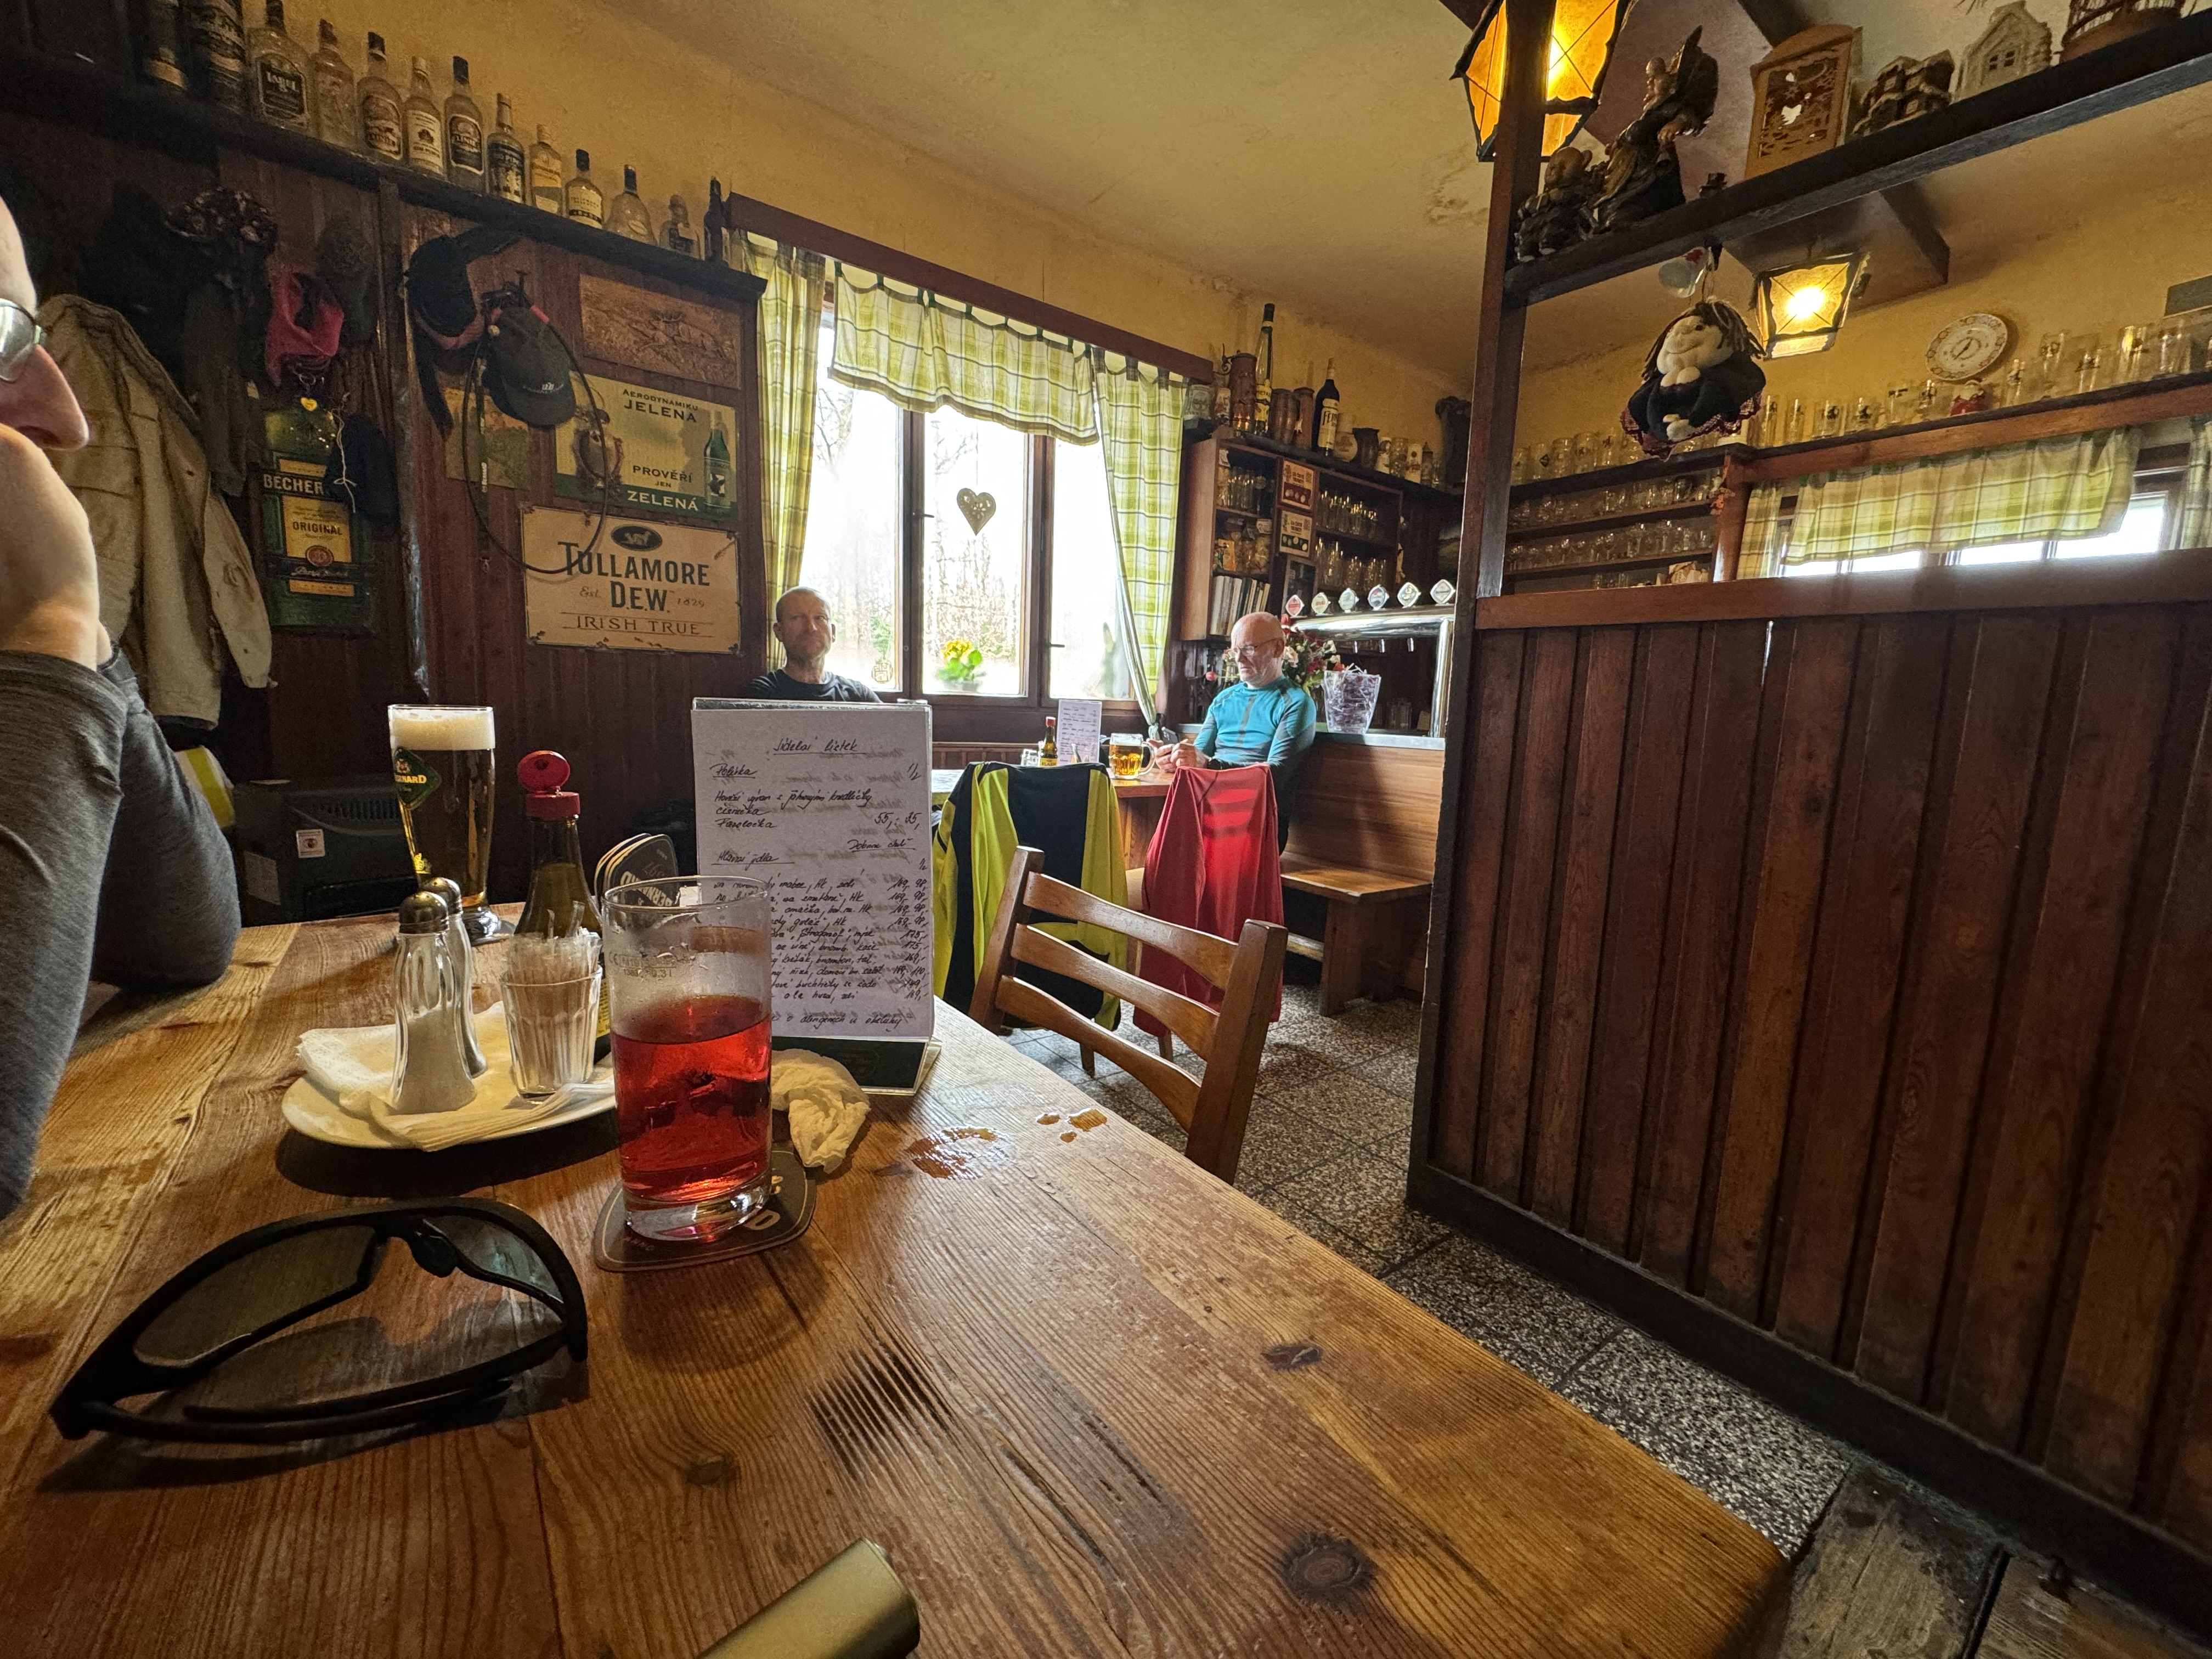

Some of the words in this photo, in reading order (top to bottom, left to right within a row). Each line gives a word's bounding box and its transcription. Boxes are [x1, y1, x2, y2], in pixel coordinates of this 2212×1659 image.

[623, 389, 698, 411] AERODYNAMIKU
[624, 400, 697, 423] JELENA
[263, 473, 324, 495] BECHER
[633, 465, 692, 483] PROVĚŘÍ
[627, 490, 698, 511] ZELENÁ
[292, 521, 343, 536] ORIGINAL
[557, 541, 710, 586] TULLAMORE
[610, 580, 670, 613] D.E.W.
[676, 597, 704, 608] 1829
[577, 615, 636, 631] IRISH
[648, 620, 701, 635] TRUE
